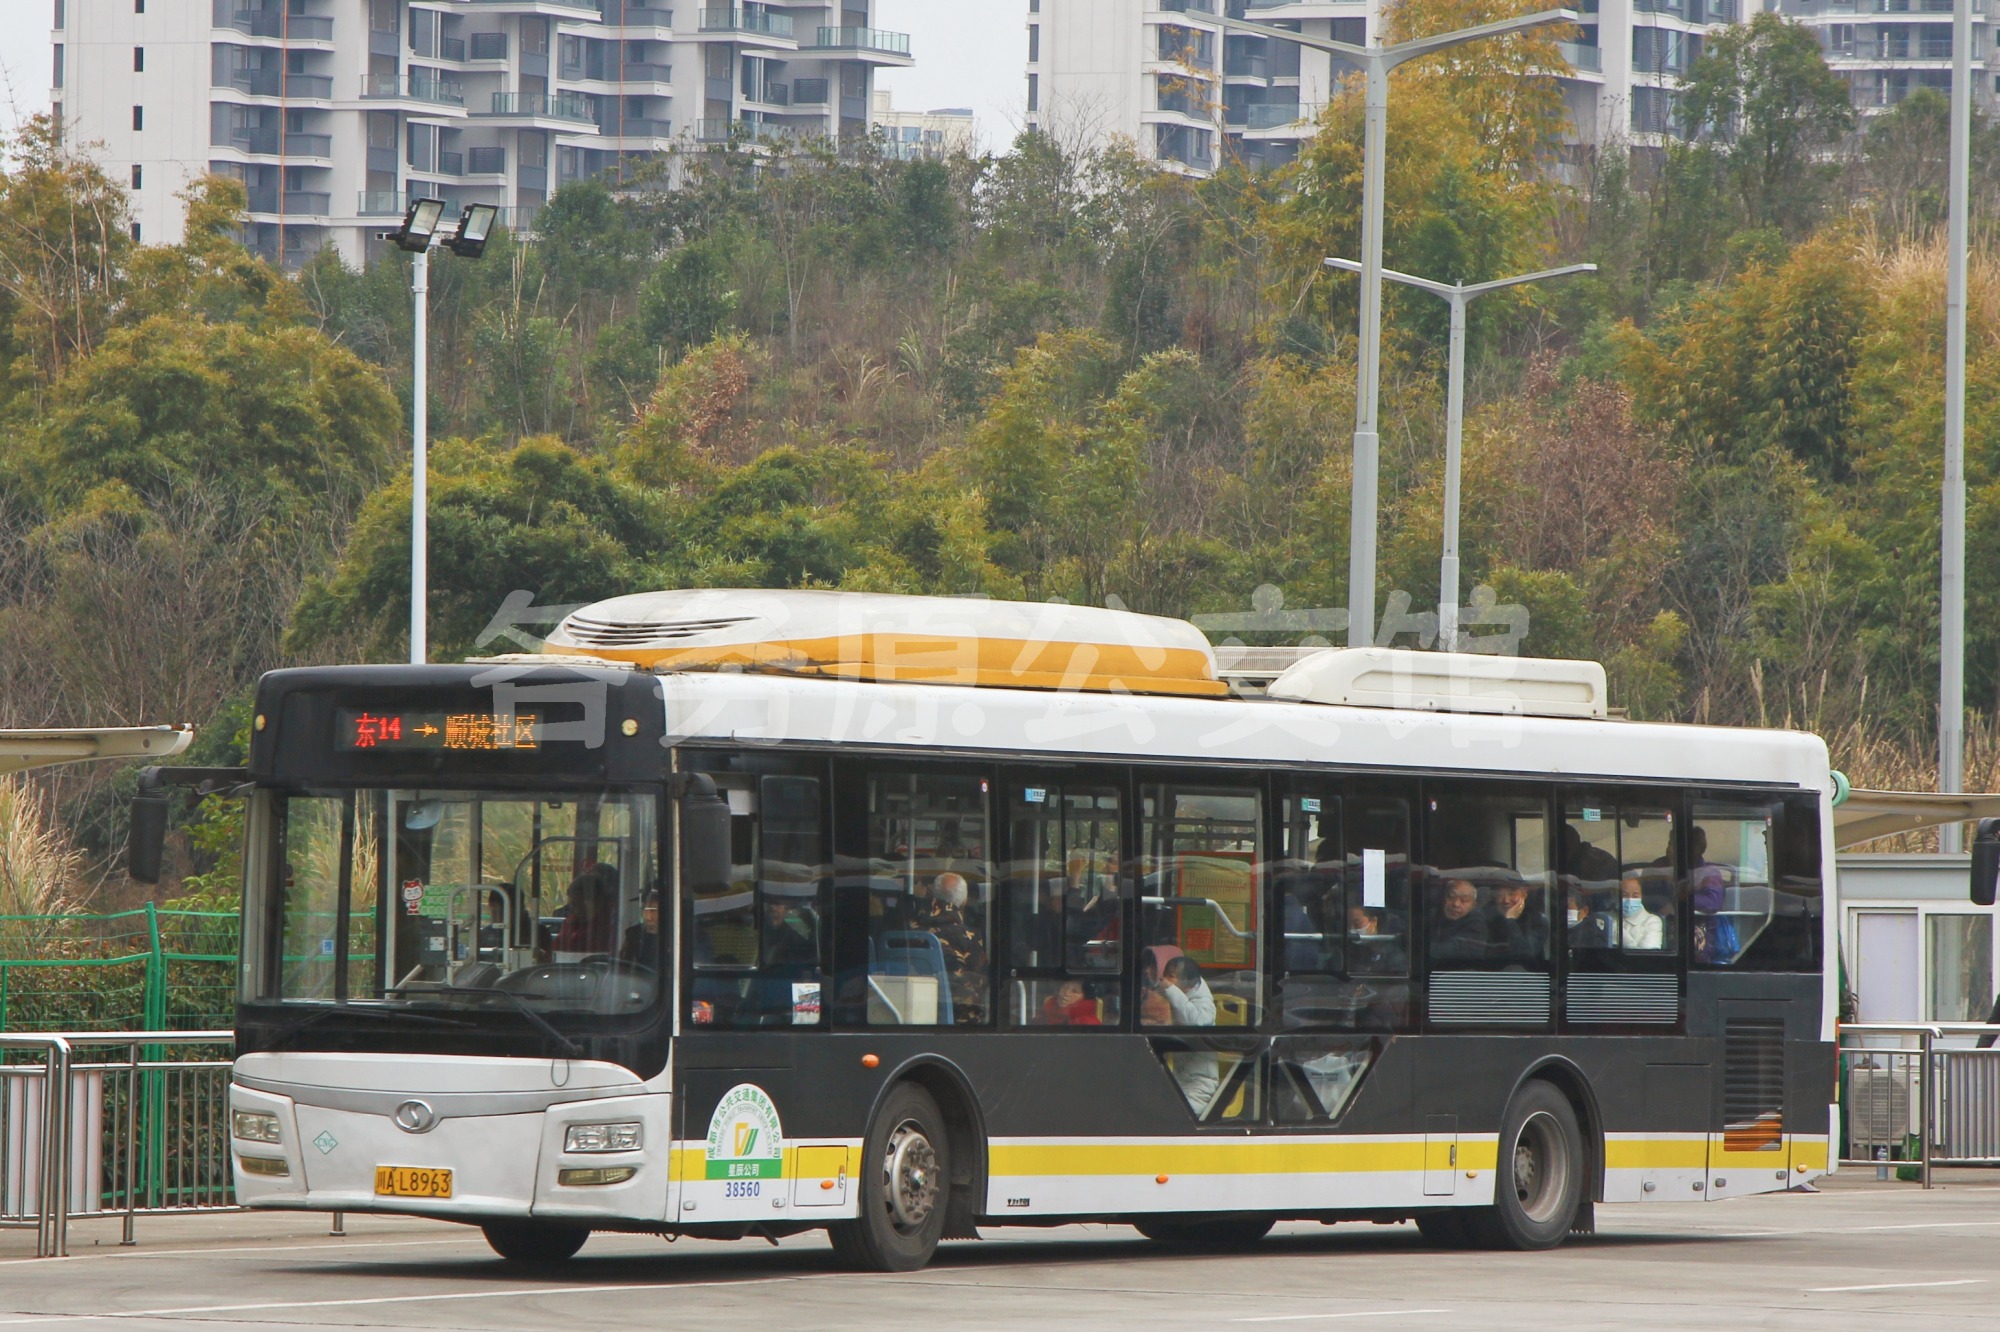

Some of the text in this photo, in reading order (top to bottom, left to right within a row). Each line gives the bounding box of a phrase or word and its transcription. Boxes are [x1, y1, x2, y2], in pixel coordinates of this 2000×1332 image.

[355, 712, 401, 748] 东14
[728, 1163, 760, 1177] 星辰公司
[725, 1181, 760, 1198] 38560
